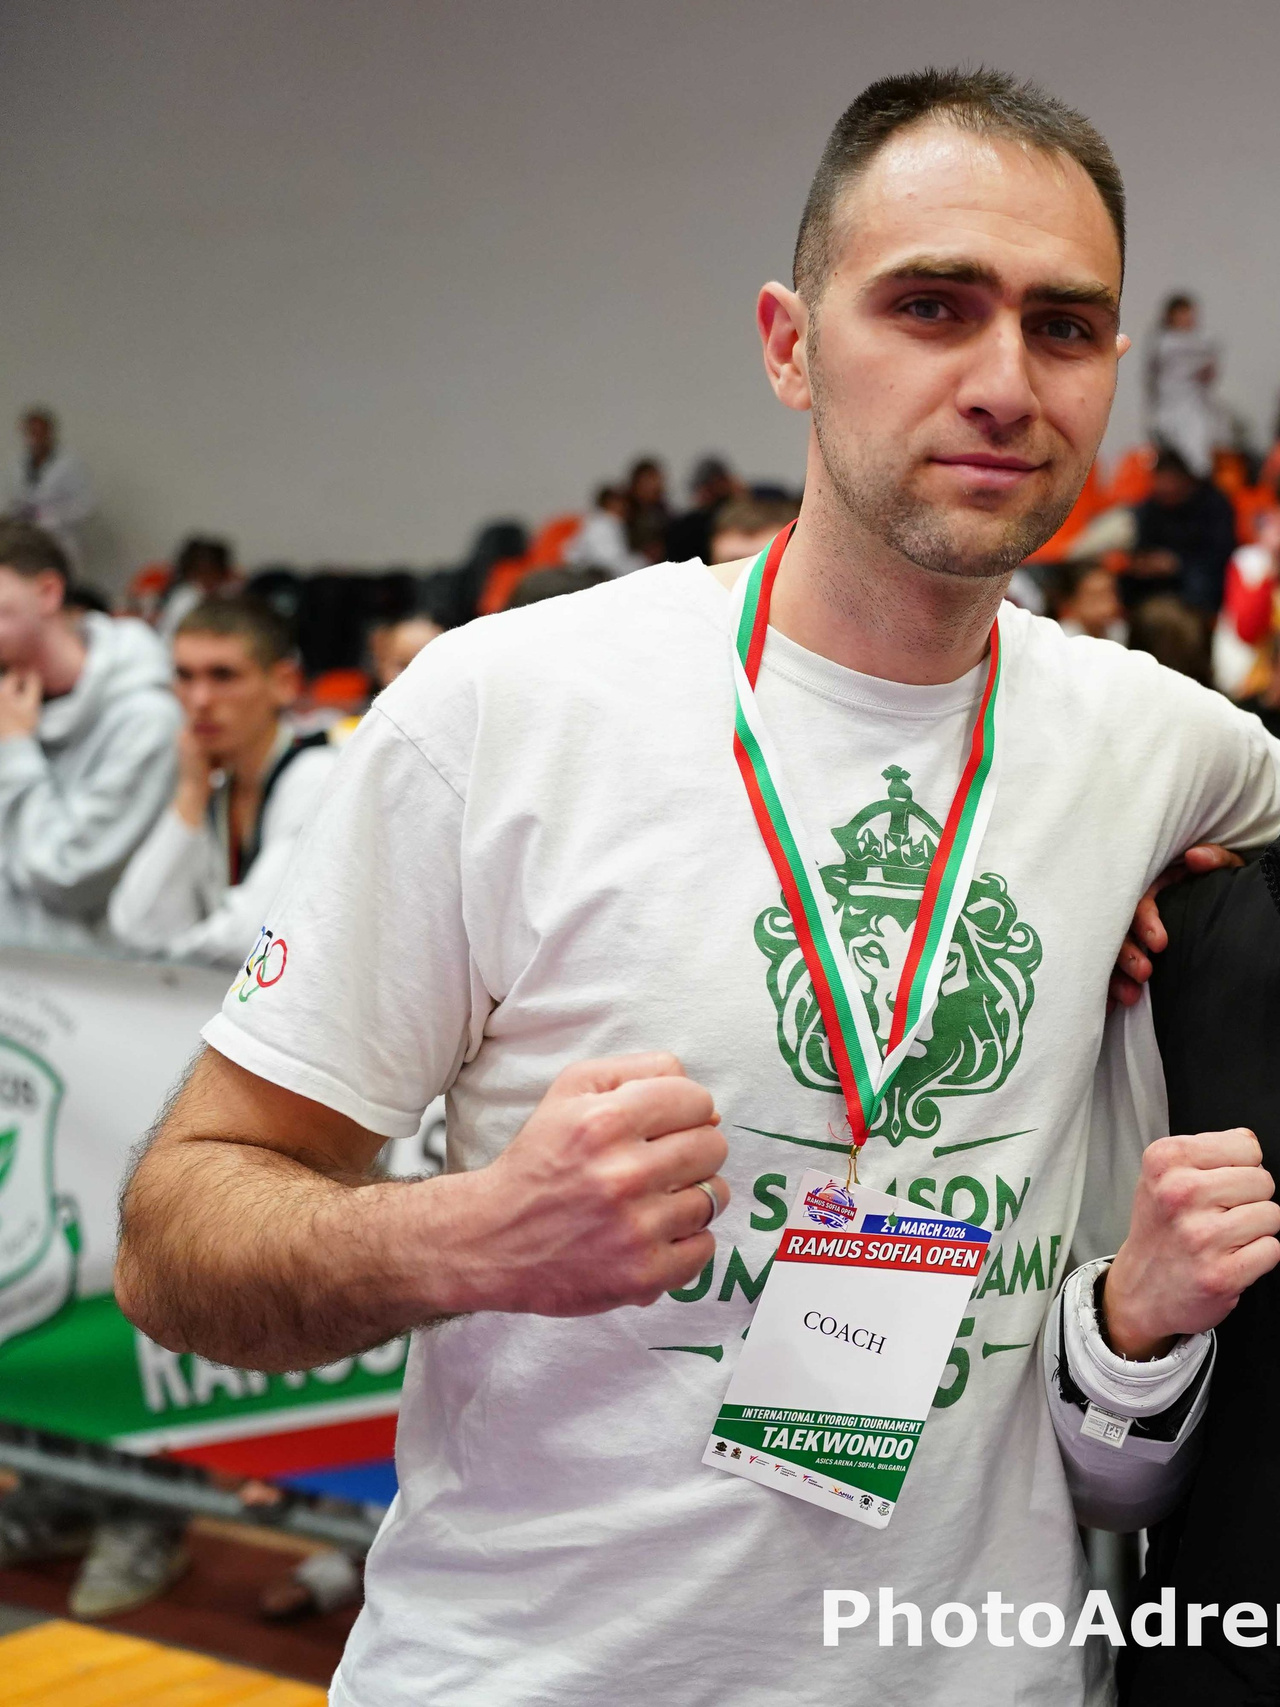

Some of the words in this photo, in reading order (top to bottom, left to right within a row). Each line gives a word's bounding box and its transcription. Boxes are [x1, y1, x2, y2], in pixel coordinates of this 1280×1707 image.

[750, 1173, 1030, 1232] SSON
[806, 1196, 826, 1207] RAMUS
[825, 1203, 841, 1213] SOFIA
[840, 1208, 855, 1217] OPEN
[899, 1221, 943, 1237] MARCH
[942, 1227, 967, 1239] 2026
[787, 1236, 864, 1258] RAMUS
[865, 1242, 922, 1264] SOFIA
[926, 1247, 980, 1269] OPEN
[803, 1311, 887, 1355] COACH
[741, 1407, 815, 1424] INTERNATIONAL
[817, 1414, 858, 1427] KYORUGI
[859, 1418, 922, 1432] TOURNAMENT
[761, 1426, 914, 1460] TAEKWONDO
[815, 1457, 833, 1465] ASICS
[833, 1459, 853, 1467] ARENA
[858, 1461, 876, 1470] SOFIA,
[877, 1463, 906, 1472] BULGARIA
